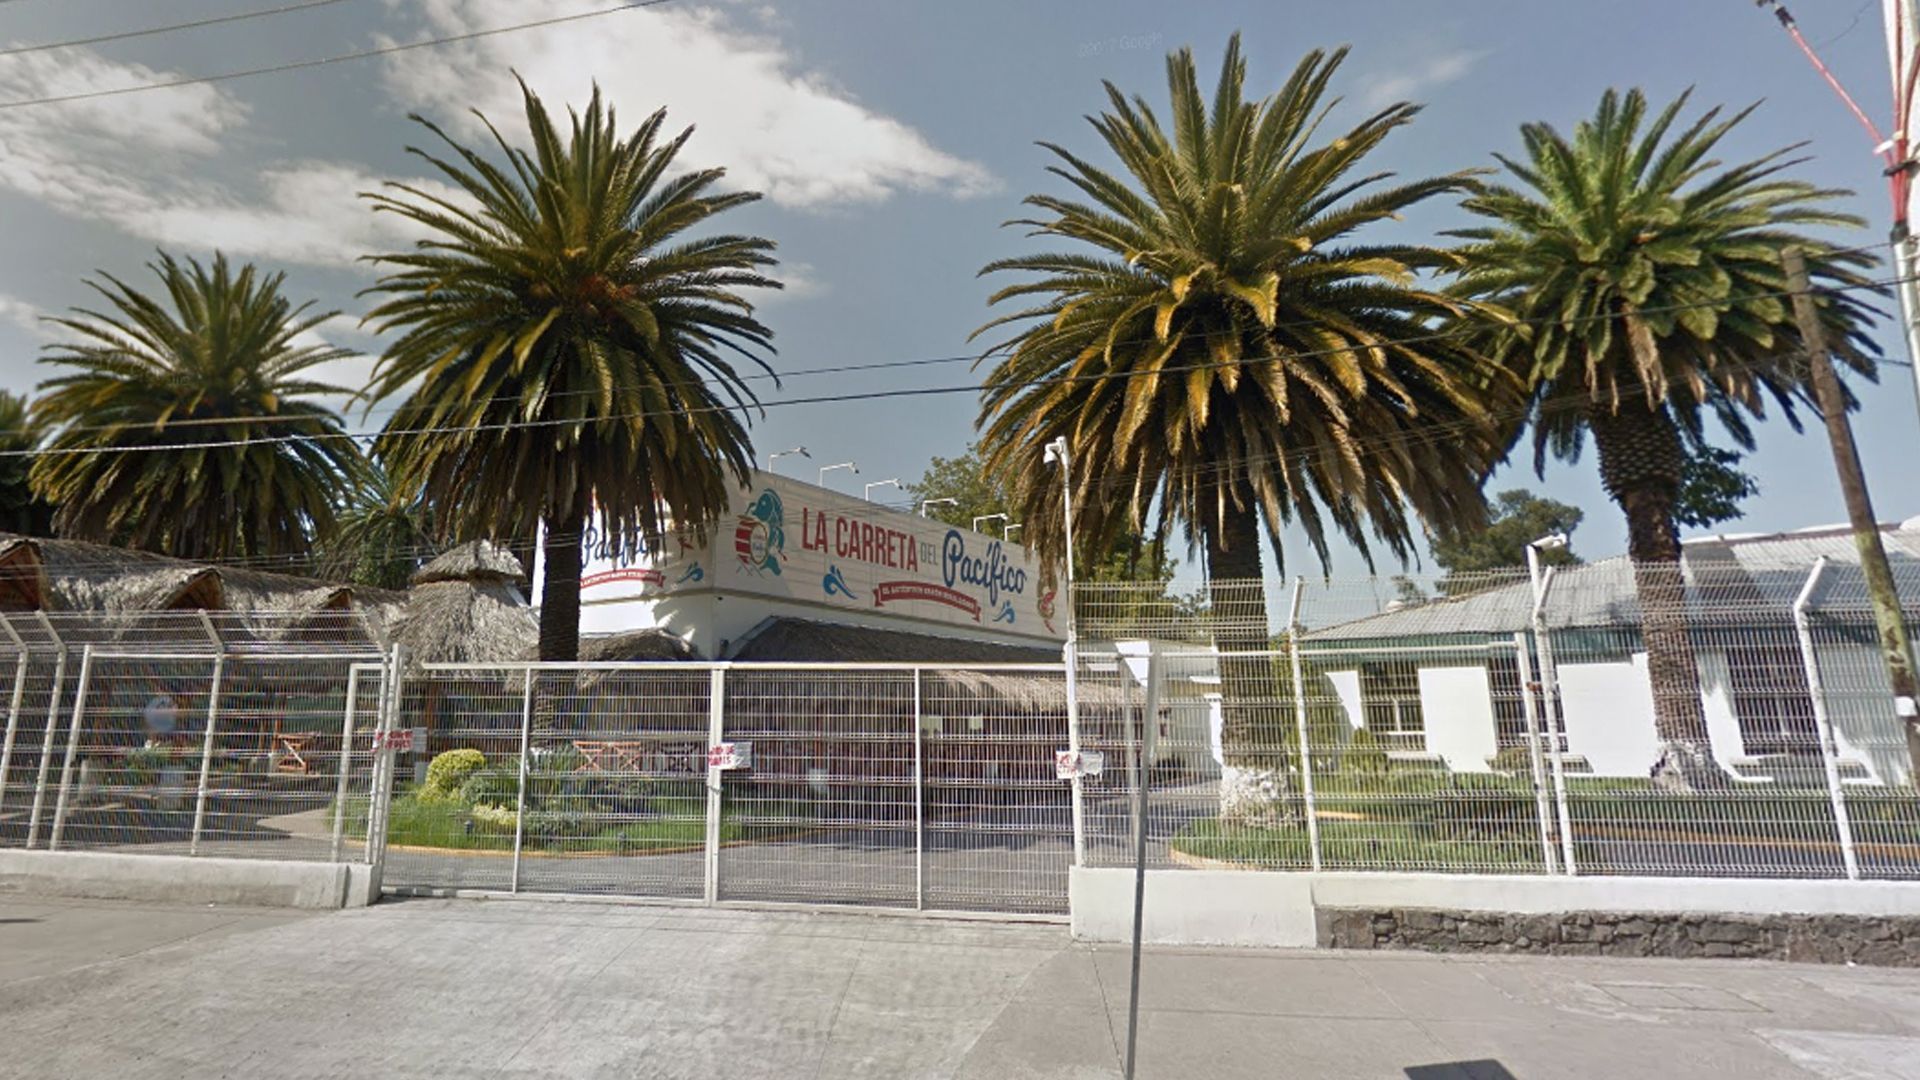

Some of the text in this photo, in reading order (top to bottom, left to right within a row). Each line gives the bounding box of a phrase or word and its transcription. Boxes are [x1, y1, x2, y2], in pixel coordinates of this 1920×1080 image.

[802, 507, 829, 554] LA
[835, 516, 918, 573] CARRETA
[920, 541, 939, 566] DEL
[942, 529, 1028, 607] Pacífico
